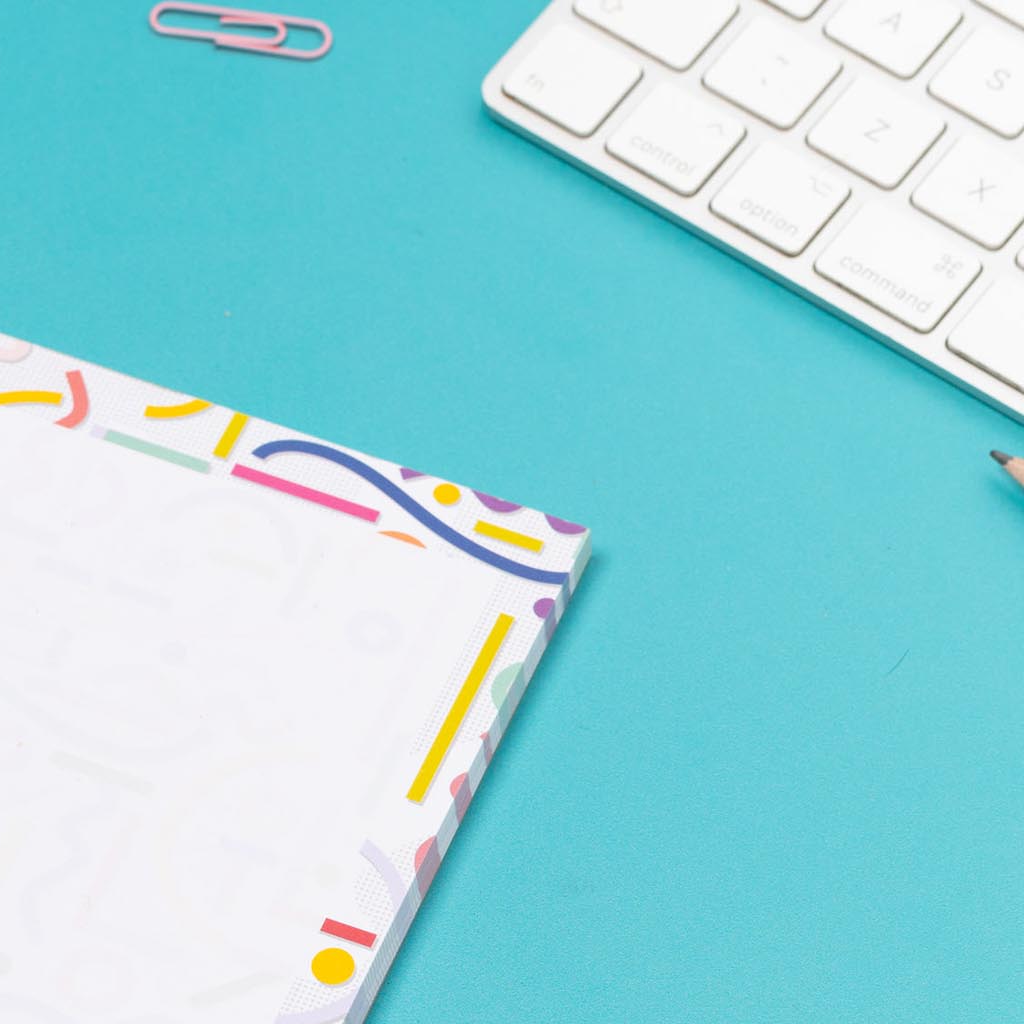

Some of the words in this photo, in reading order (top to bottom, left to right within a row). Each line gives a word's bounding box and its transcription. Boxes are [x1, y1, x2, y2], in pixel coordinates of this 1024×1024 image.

[880, 10, 904, 34] A
[985, 67, 1012, 92] S
[863, 116, 892, 144] Z
[628, 133, 698, 177] control
[966, 177, 998, 204] X
[738, 196, 800, 239] option
[837, 253, 933, 315] command
